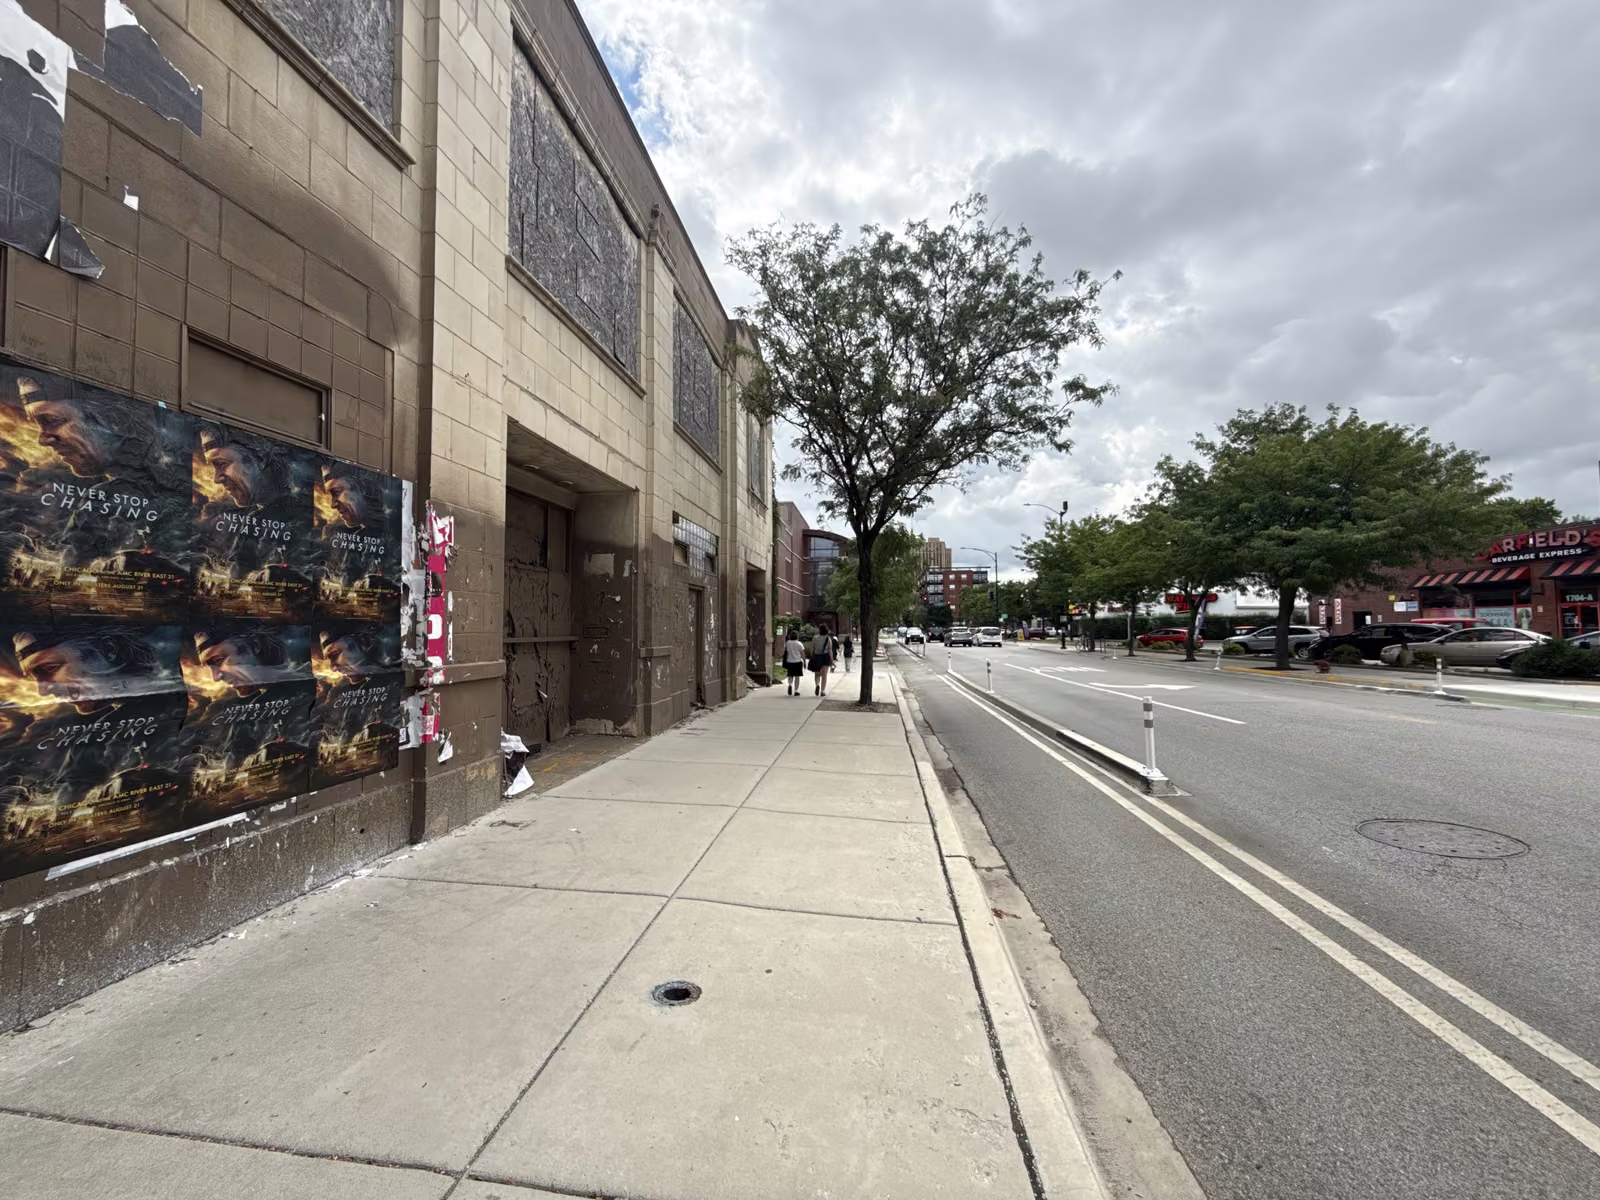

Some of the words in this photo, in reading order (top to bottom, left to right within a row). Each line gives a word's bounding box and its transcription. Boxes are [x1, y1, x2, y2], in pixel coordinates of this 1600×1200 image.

[53, 482, 106, 501] NEVER
[113, 493, 149, 508] STOP
[41, 493, 158, 521] CHASING
[223, 512, 257, 525] NEVER
[261, 518, 286, 530] STOP
[215, 521, 292, 541] CHASING
[337, 531, 361, 542] NEVER
[363, 536, 381, 545] STOP
[331, 539, 385, 555] CHASING
[1475, 528, 1600, 561] ARFIELD'S
[1491, 552, 1536, 563] BEVERAGE
[1539, 547, 1583, 558] EXPRESS
[333, 693, 388, 709] CHASING
[341, 689, 366, 698] NEVER
[368, 686, 386, 695] STOP
[212, 706, 292, 726] CHASING
[224, 704, 260, 715] NEVER
[264, 699, 289, 709] STOP
[56, 722, 111, 736] NEVER
[117, 716, 155, 729] STOP
[37, 724, 158, 750] CHASING
[113, 791, 129, 799] AMC
[130, 788, 148, 796] RIVER
[149, 784, 164, 792] EAST
[48, 820, 66, 828] ONLY
[109, 804, 133, 813] AUGUST
